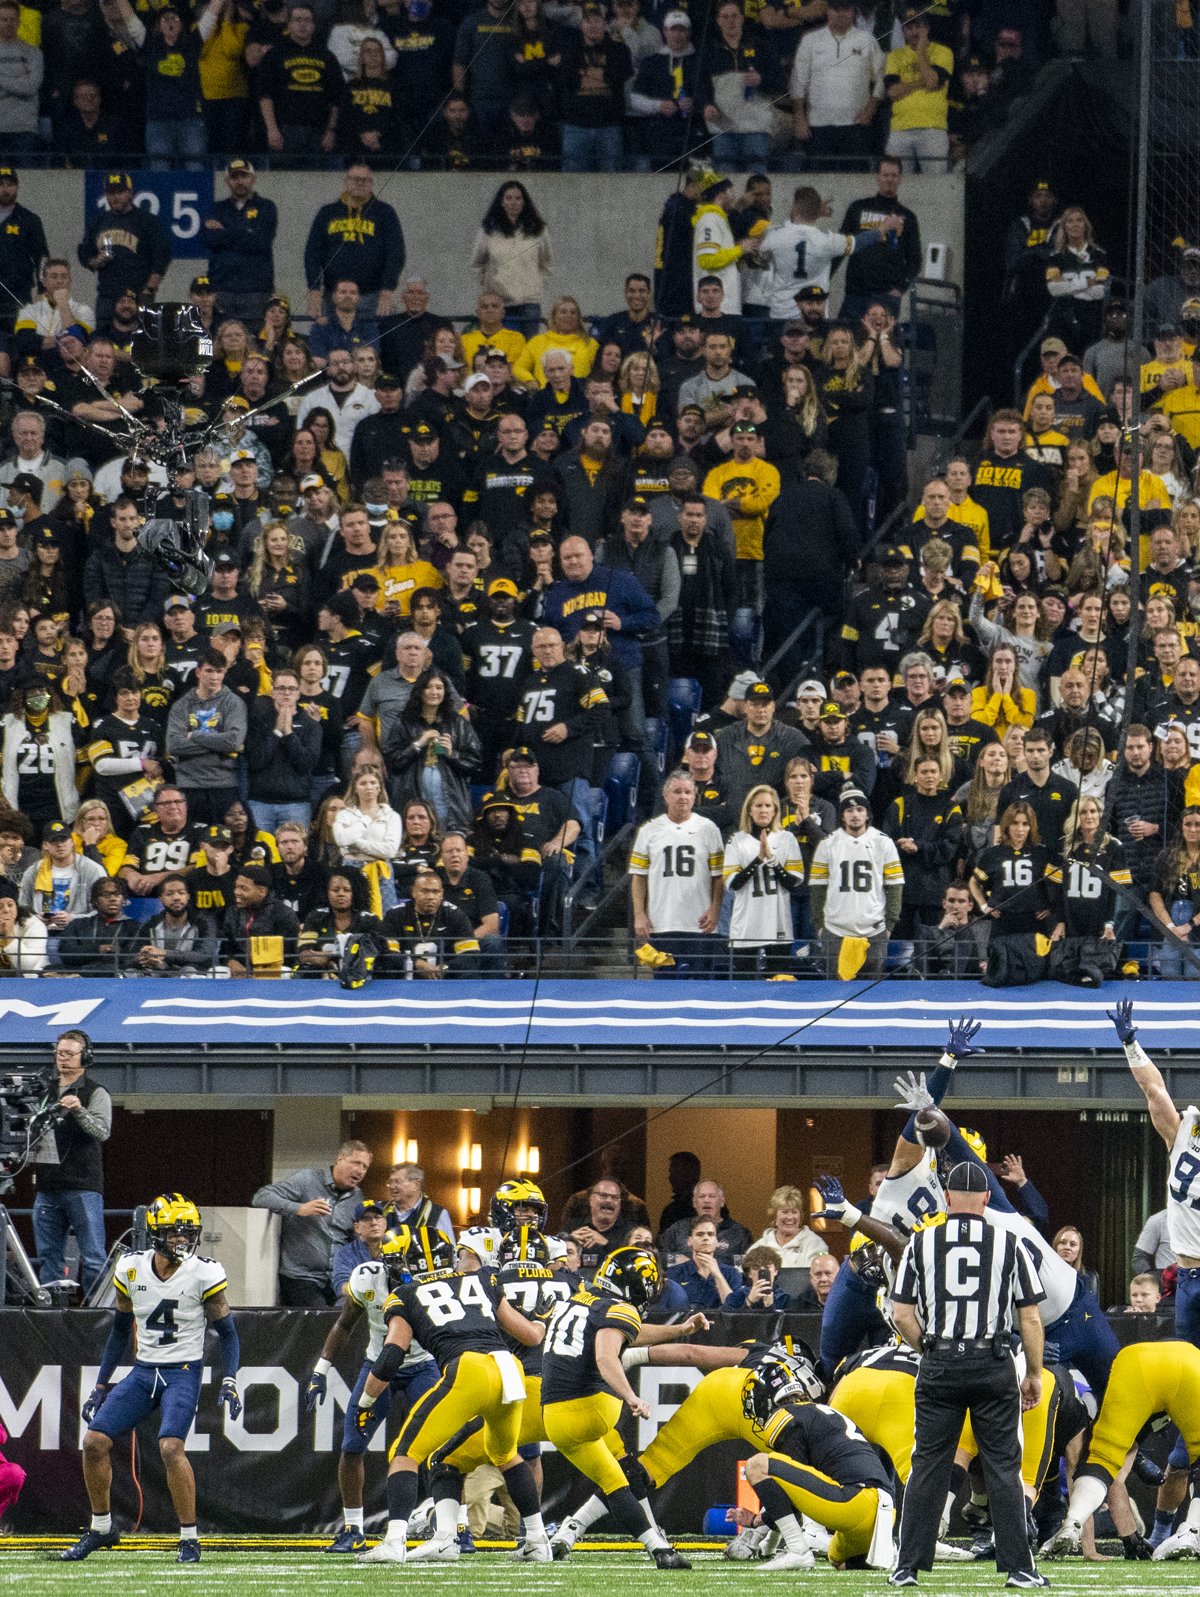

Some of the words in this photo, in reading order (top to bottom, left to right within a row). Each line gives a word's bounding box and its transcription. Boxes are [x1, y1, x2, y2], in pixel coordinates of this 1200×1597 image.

[794, 241, 808, 277] 1
[205, 614, 241, 626] IOWA
[479, 646, 523, 678] 37
[524, 689, 556, 723] 75
[145, 841, 190, 872] 99
[663, 845, 696, 877] 16
[1002, 859, 1033, 886] 16
[839, 860, 873, 893] 16
[1068, 861, 1102, 899] 16
[518, 1268, 553, 1279] PLUMB
[945, 1246, 981, 1297] C
[416, 1275, 496, 1327] 84
[146, 1299, 179, 1345] 4
[958, 1343, 965, 1352] S
